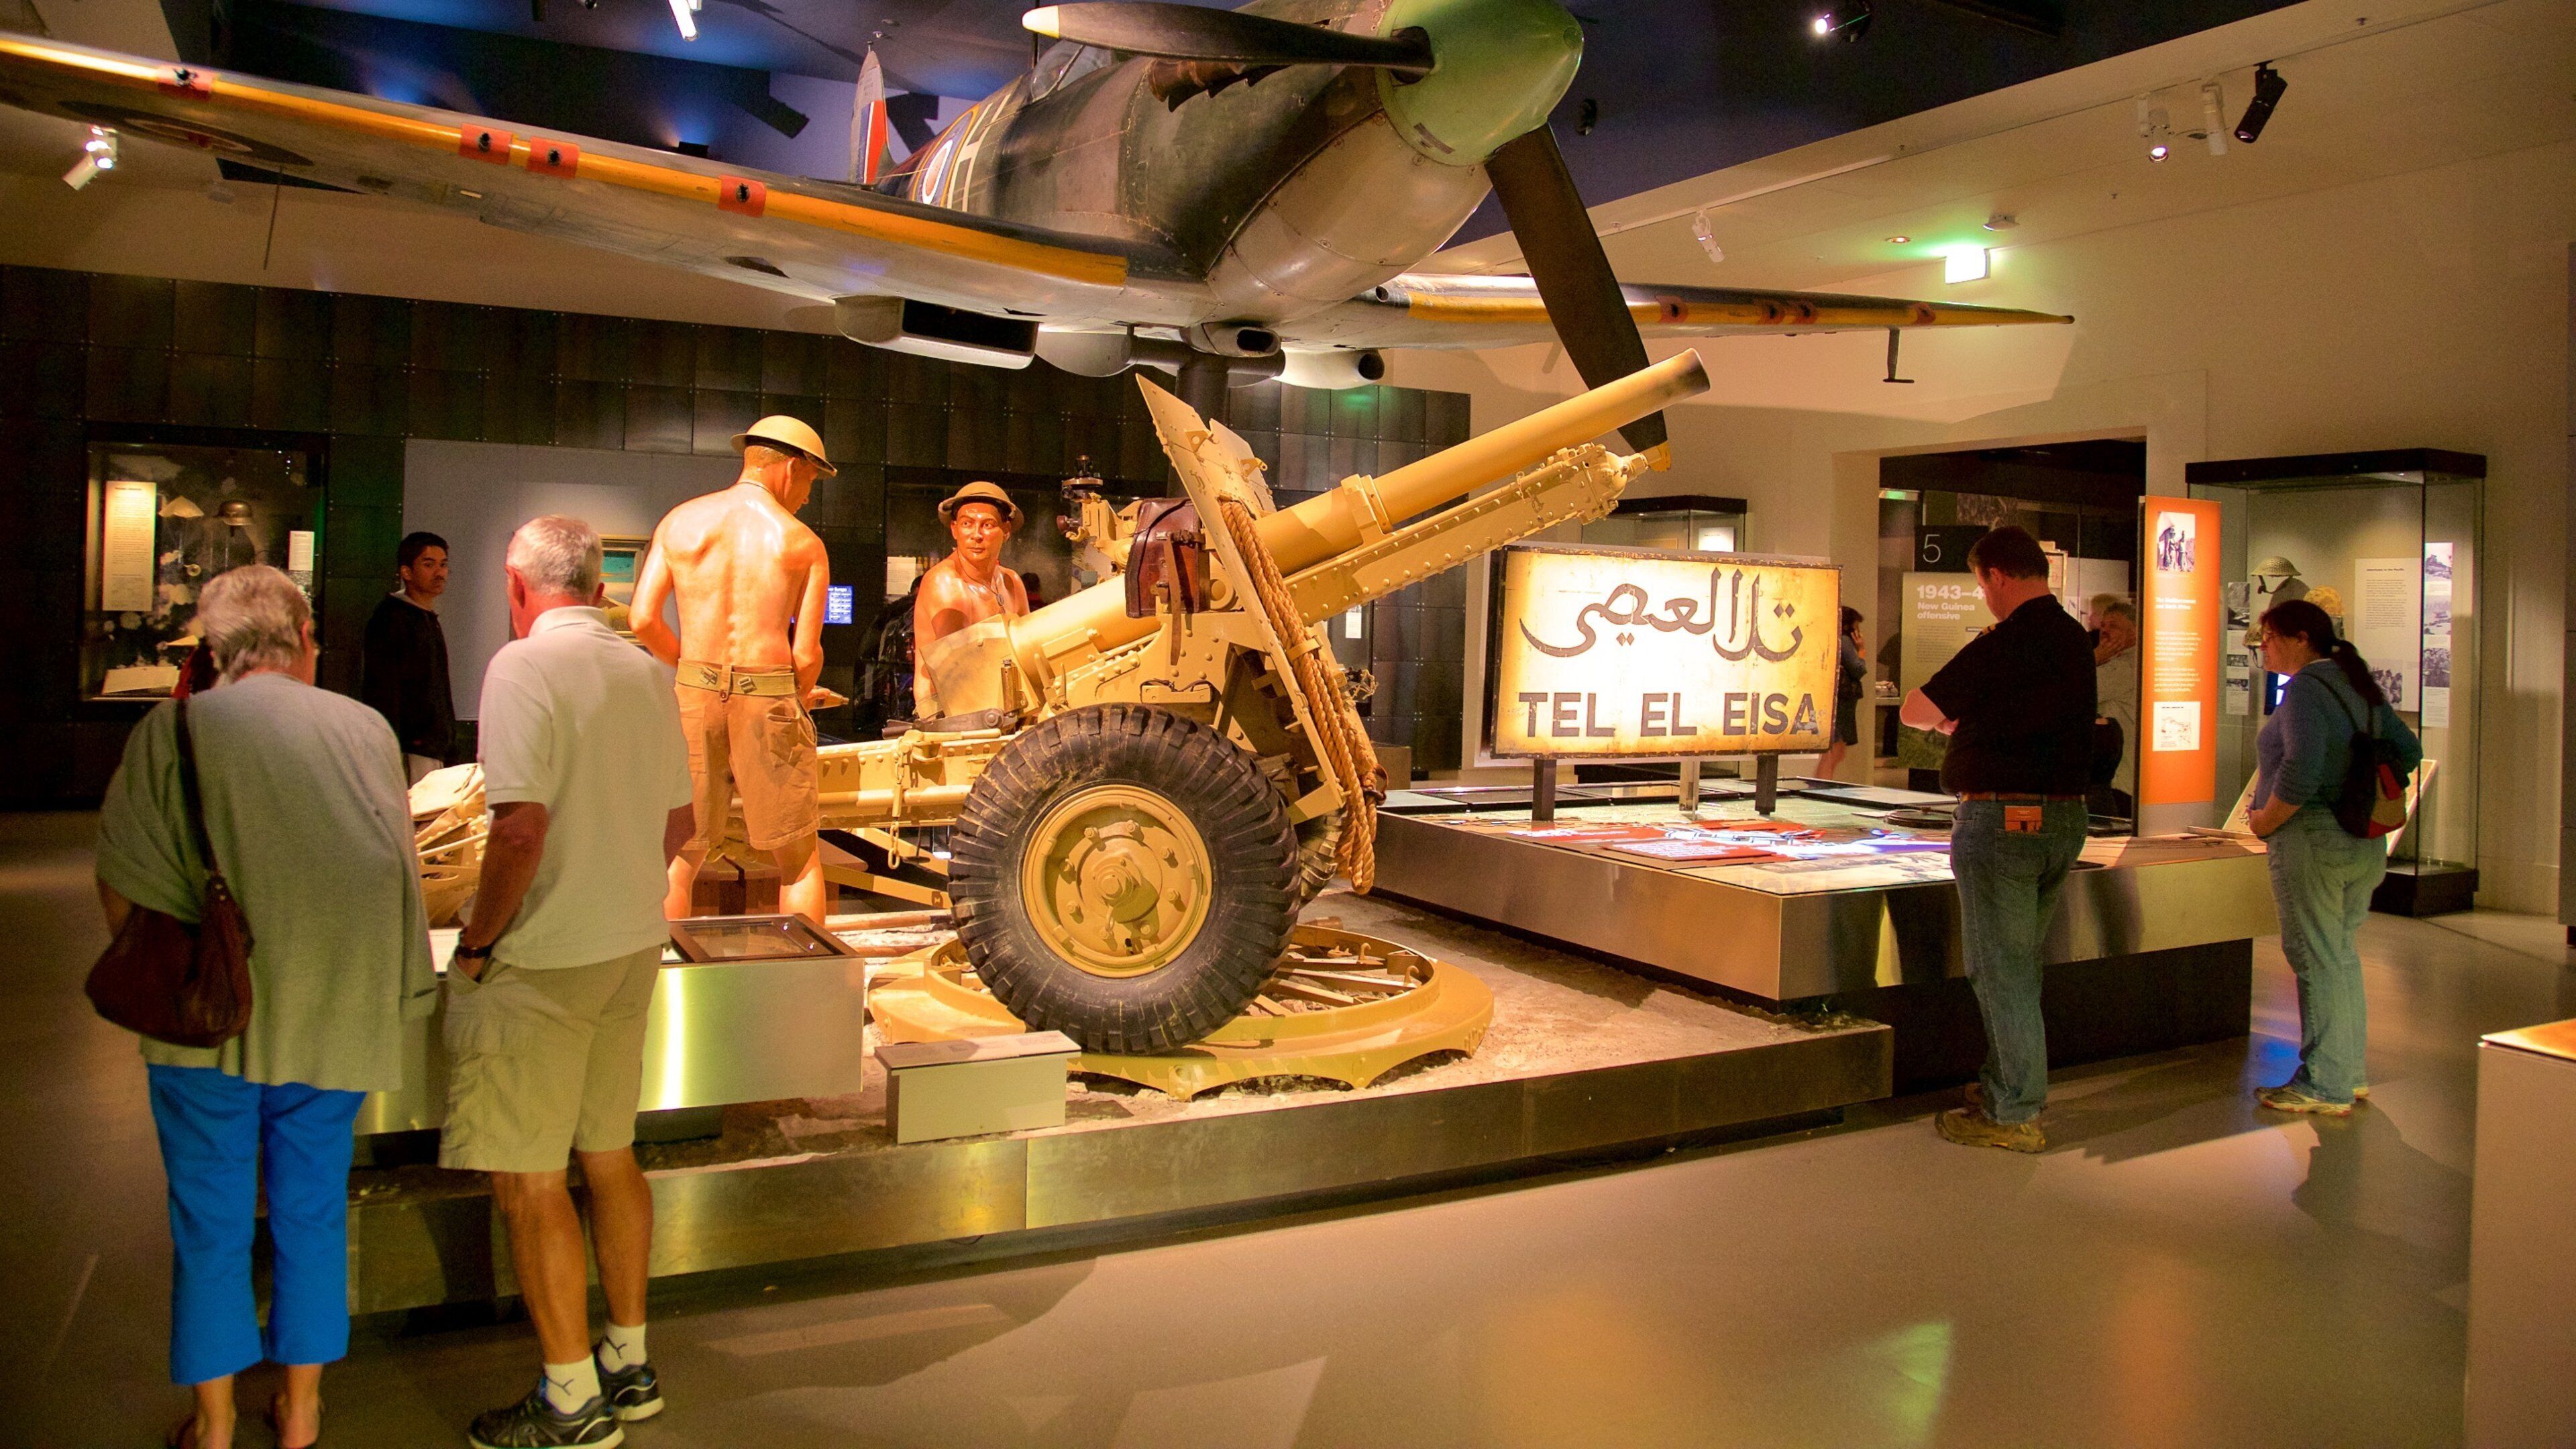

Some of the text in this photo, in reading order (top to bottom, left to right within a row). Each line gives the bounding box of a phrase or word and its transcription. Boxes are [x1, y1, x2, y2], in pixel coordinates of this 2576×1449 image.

[1923, 534, 1941, 563] 5
[1917, 584, 1984, 600] 1943–4
[1917, 602, 1975, 611] New Guinea
[1917, 611, 1960, 620] offensive
[1519, 692, 1819, 737] TEL EL EISA
